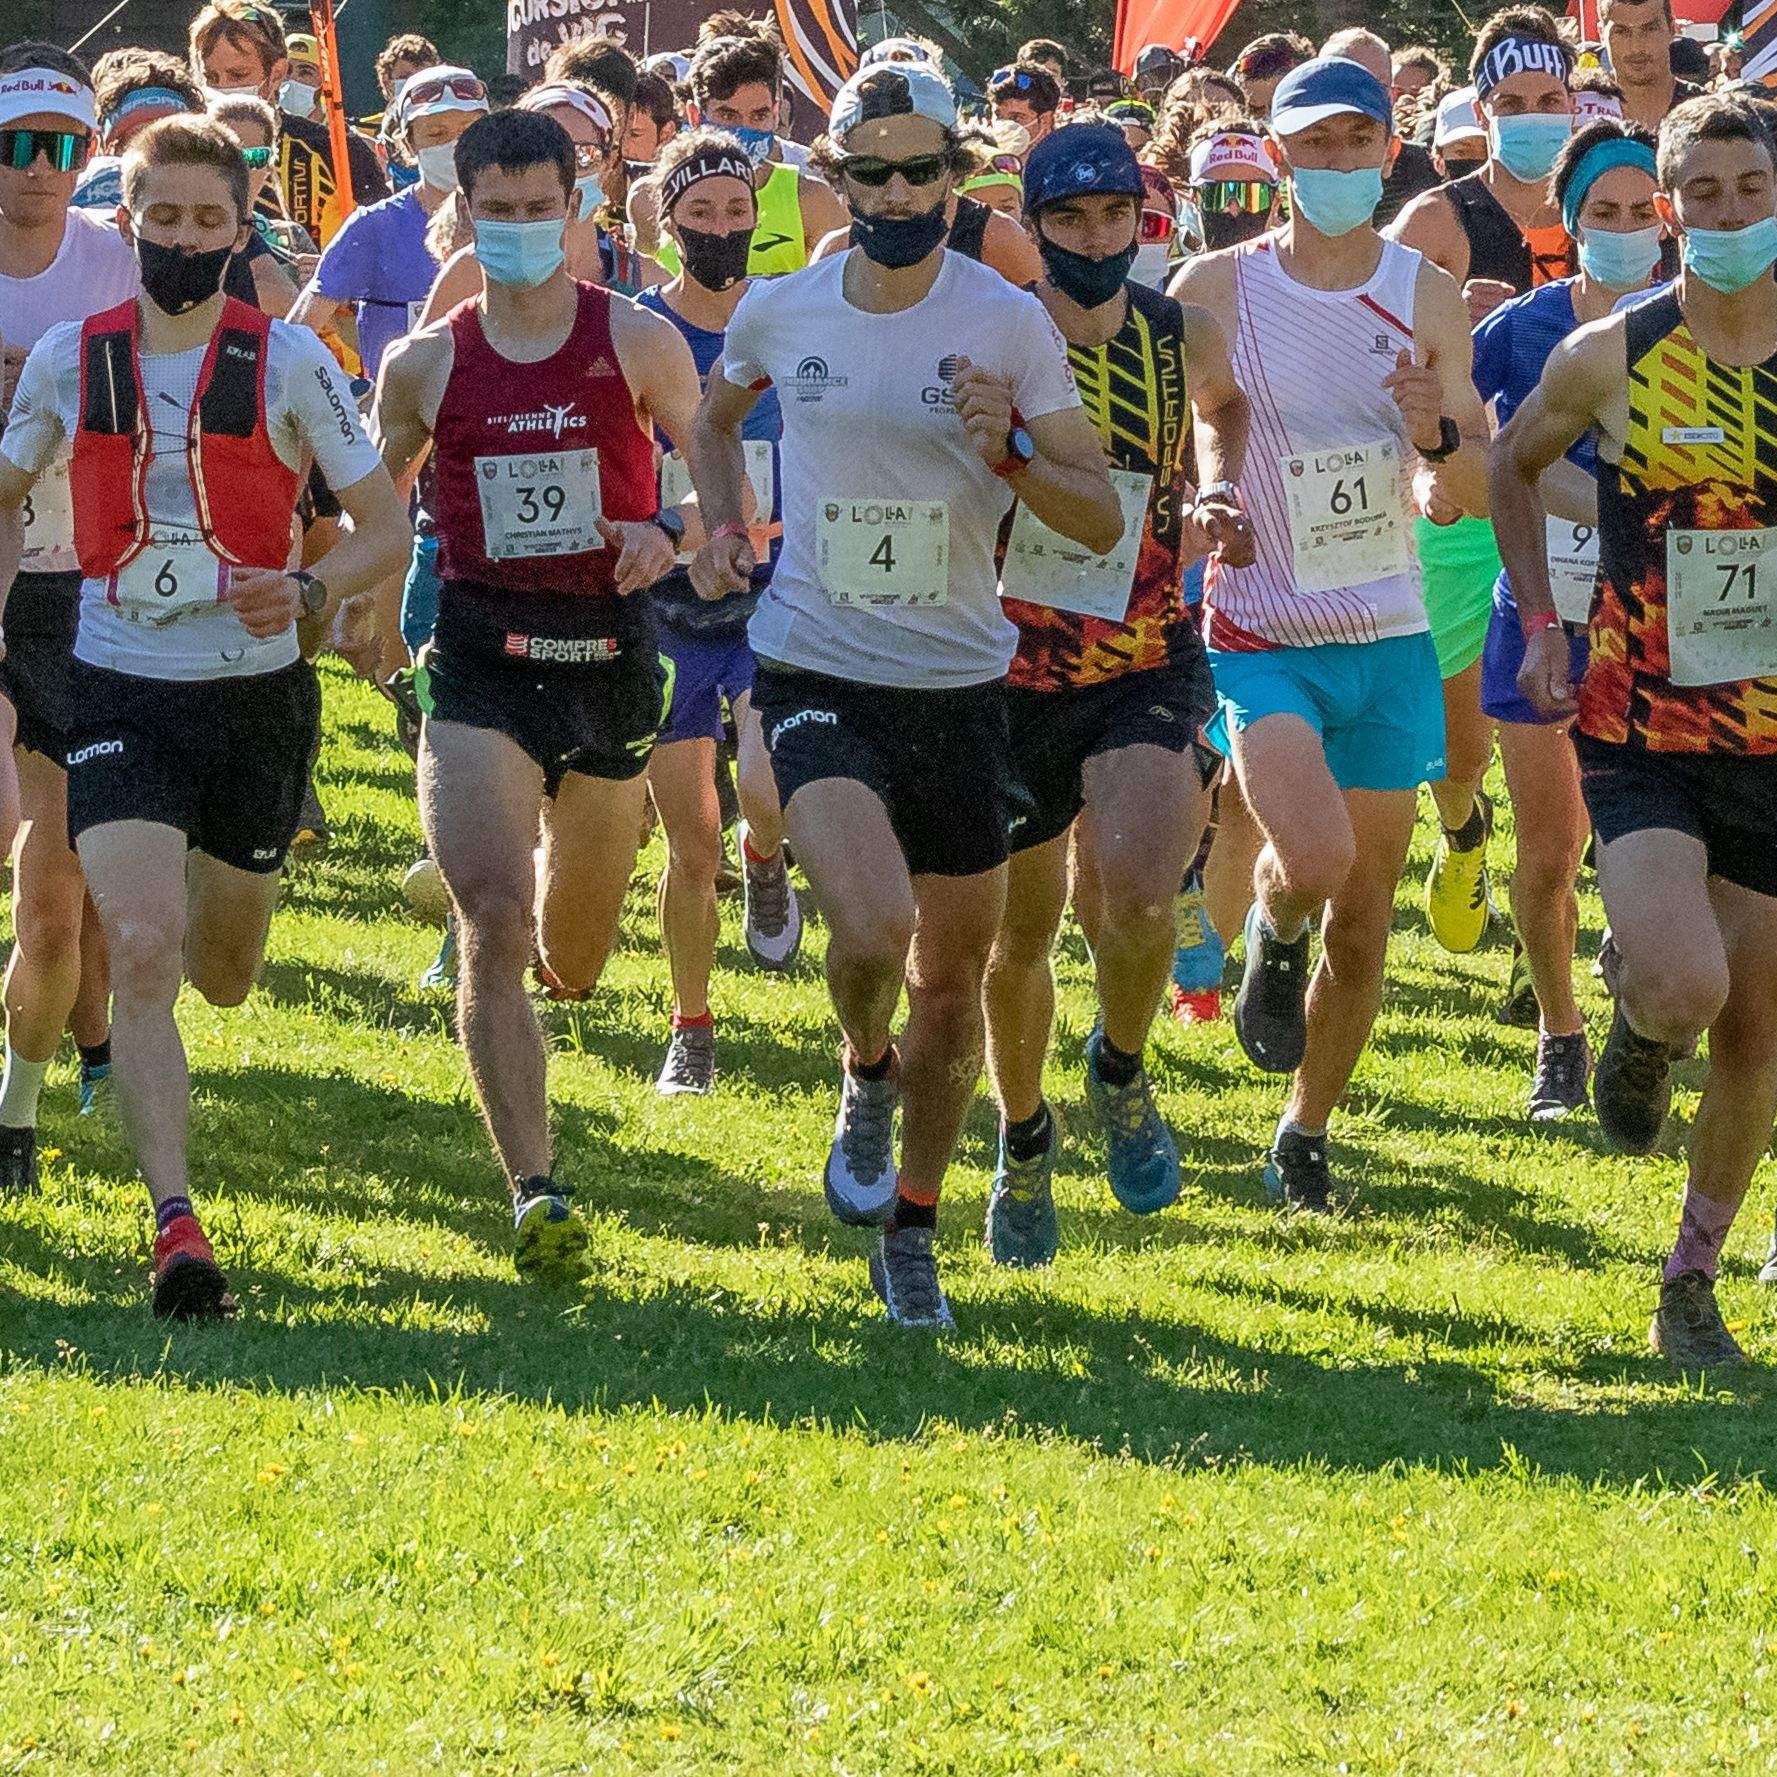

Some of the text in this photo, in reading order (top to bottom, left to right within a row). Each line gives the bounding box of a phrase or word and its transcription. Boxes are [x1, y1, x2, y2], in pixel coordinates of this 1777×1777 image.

[515, 485, 566, 524] 39
[1330, 476, 1368, 515] 61
[868, 534, 897, 573] 4
[154, 558, 179, 598] 6
[1716, 563, 1756, 601] 71
